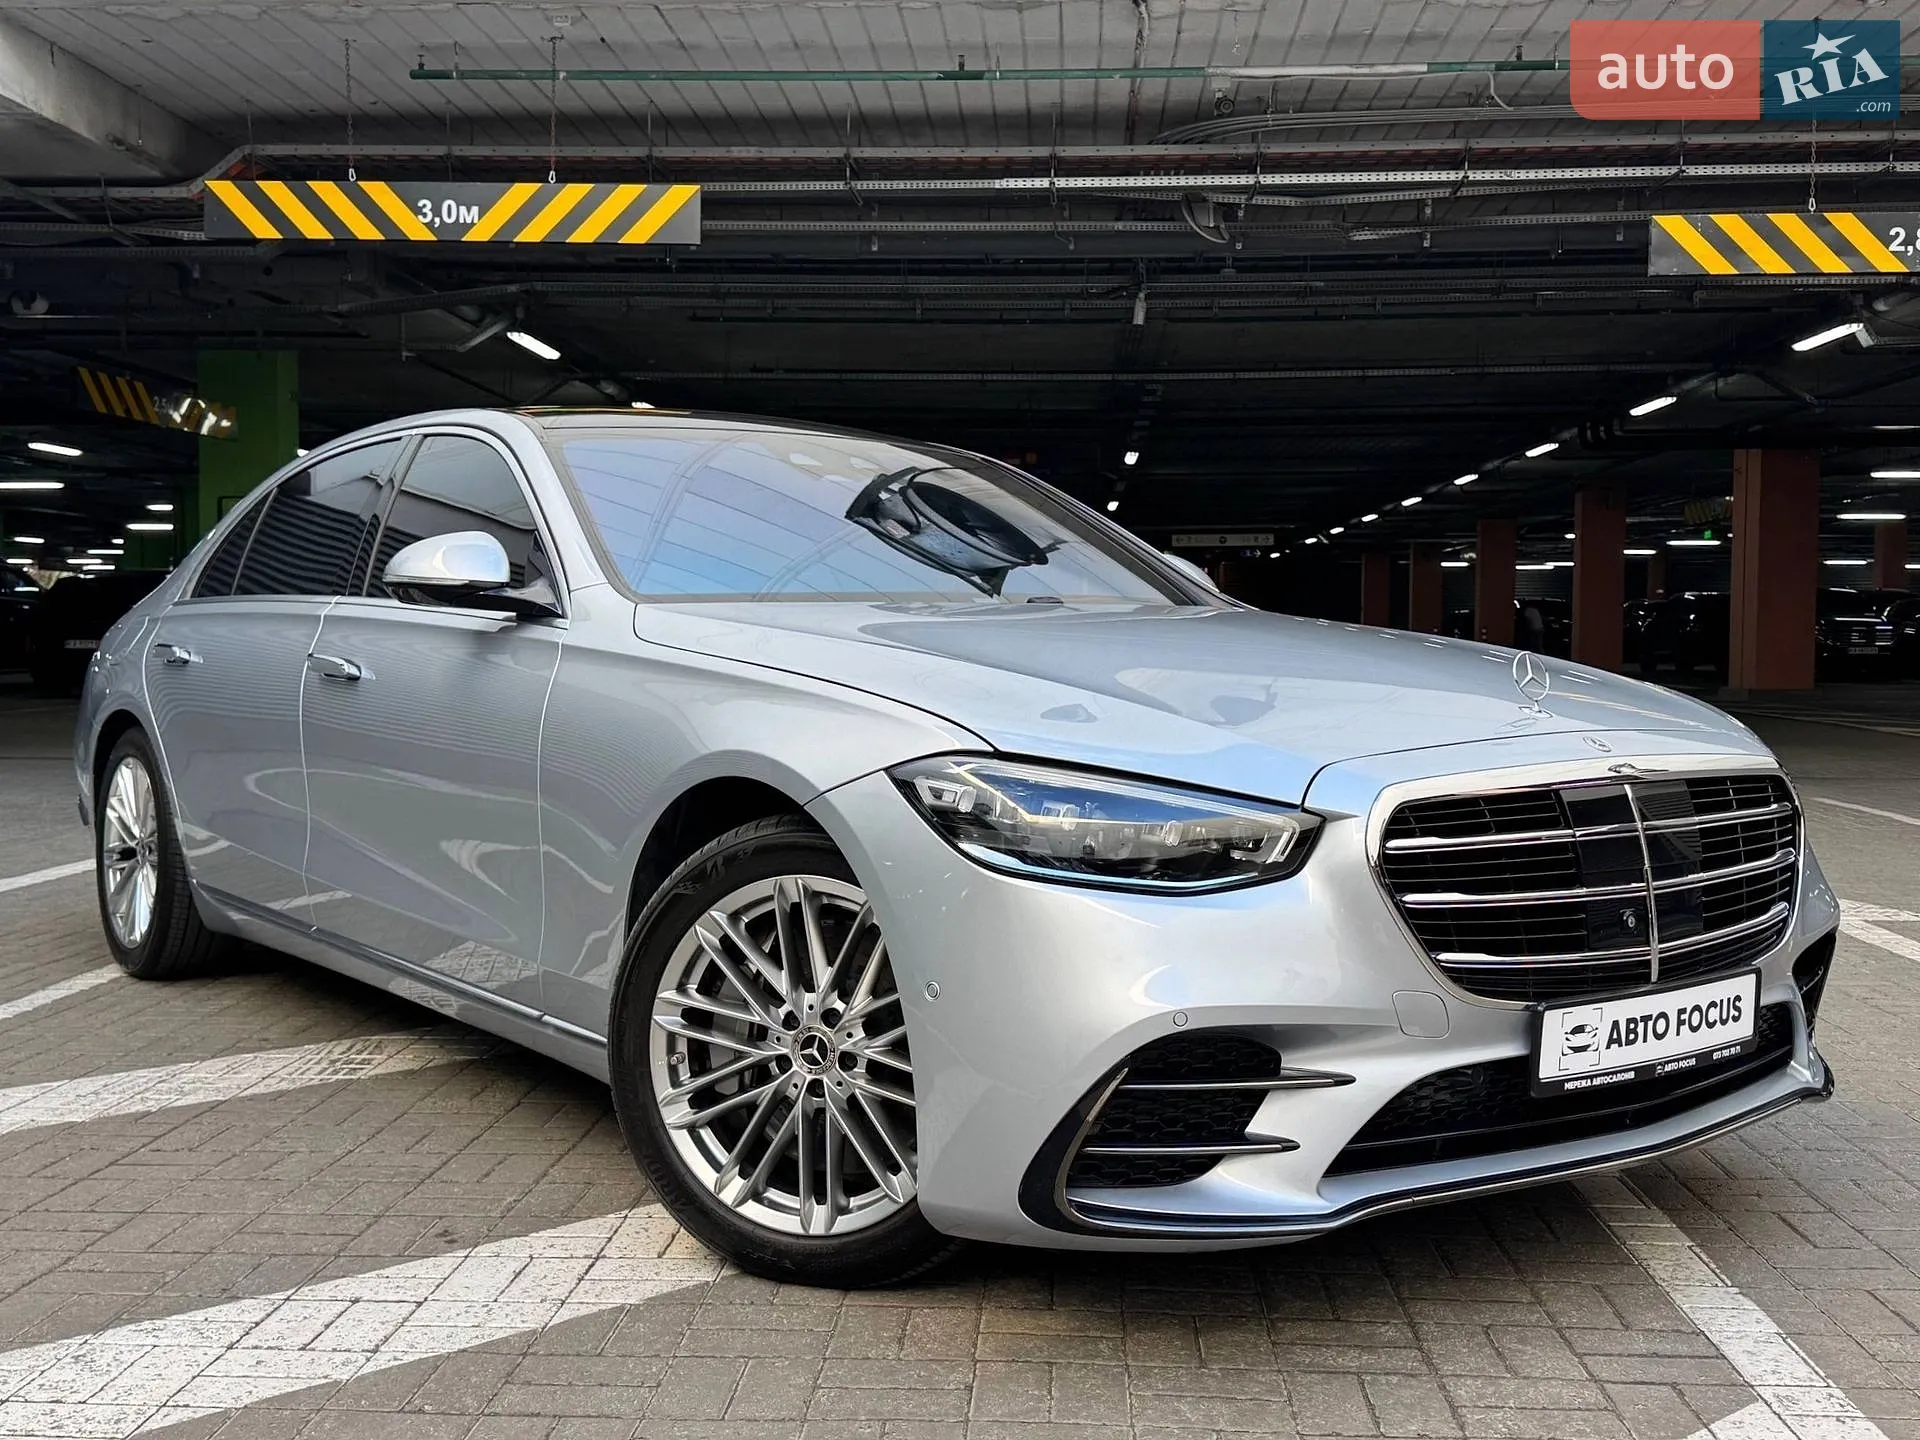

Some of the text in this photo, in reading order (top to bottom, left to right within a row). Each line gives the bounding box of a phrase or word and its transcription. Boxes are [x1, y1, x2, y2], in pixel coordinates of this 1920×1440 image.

[417, 199, 479, 228] 3,0м
[1888, 226, 1920, 257] 2,
[1605, 994, 1743, 1050] АВТО FOCUS
[1664, 1057, 1696, 1072] АВТО FOCUS
